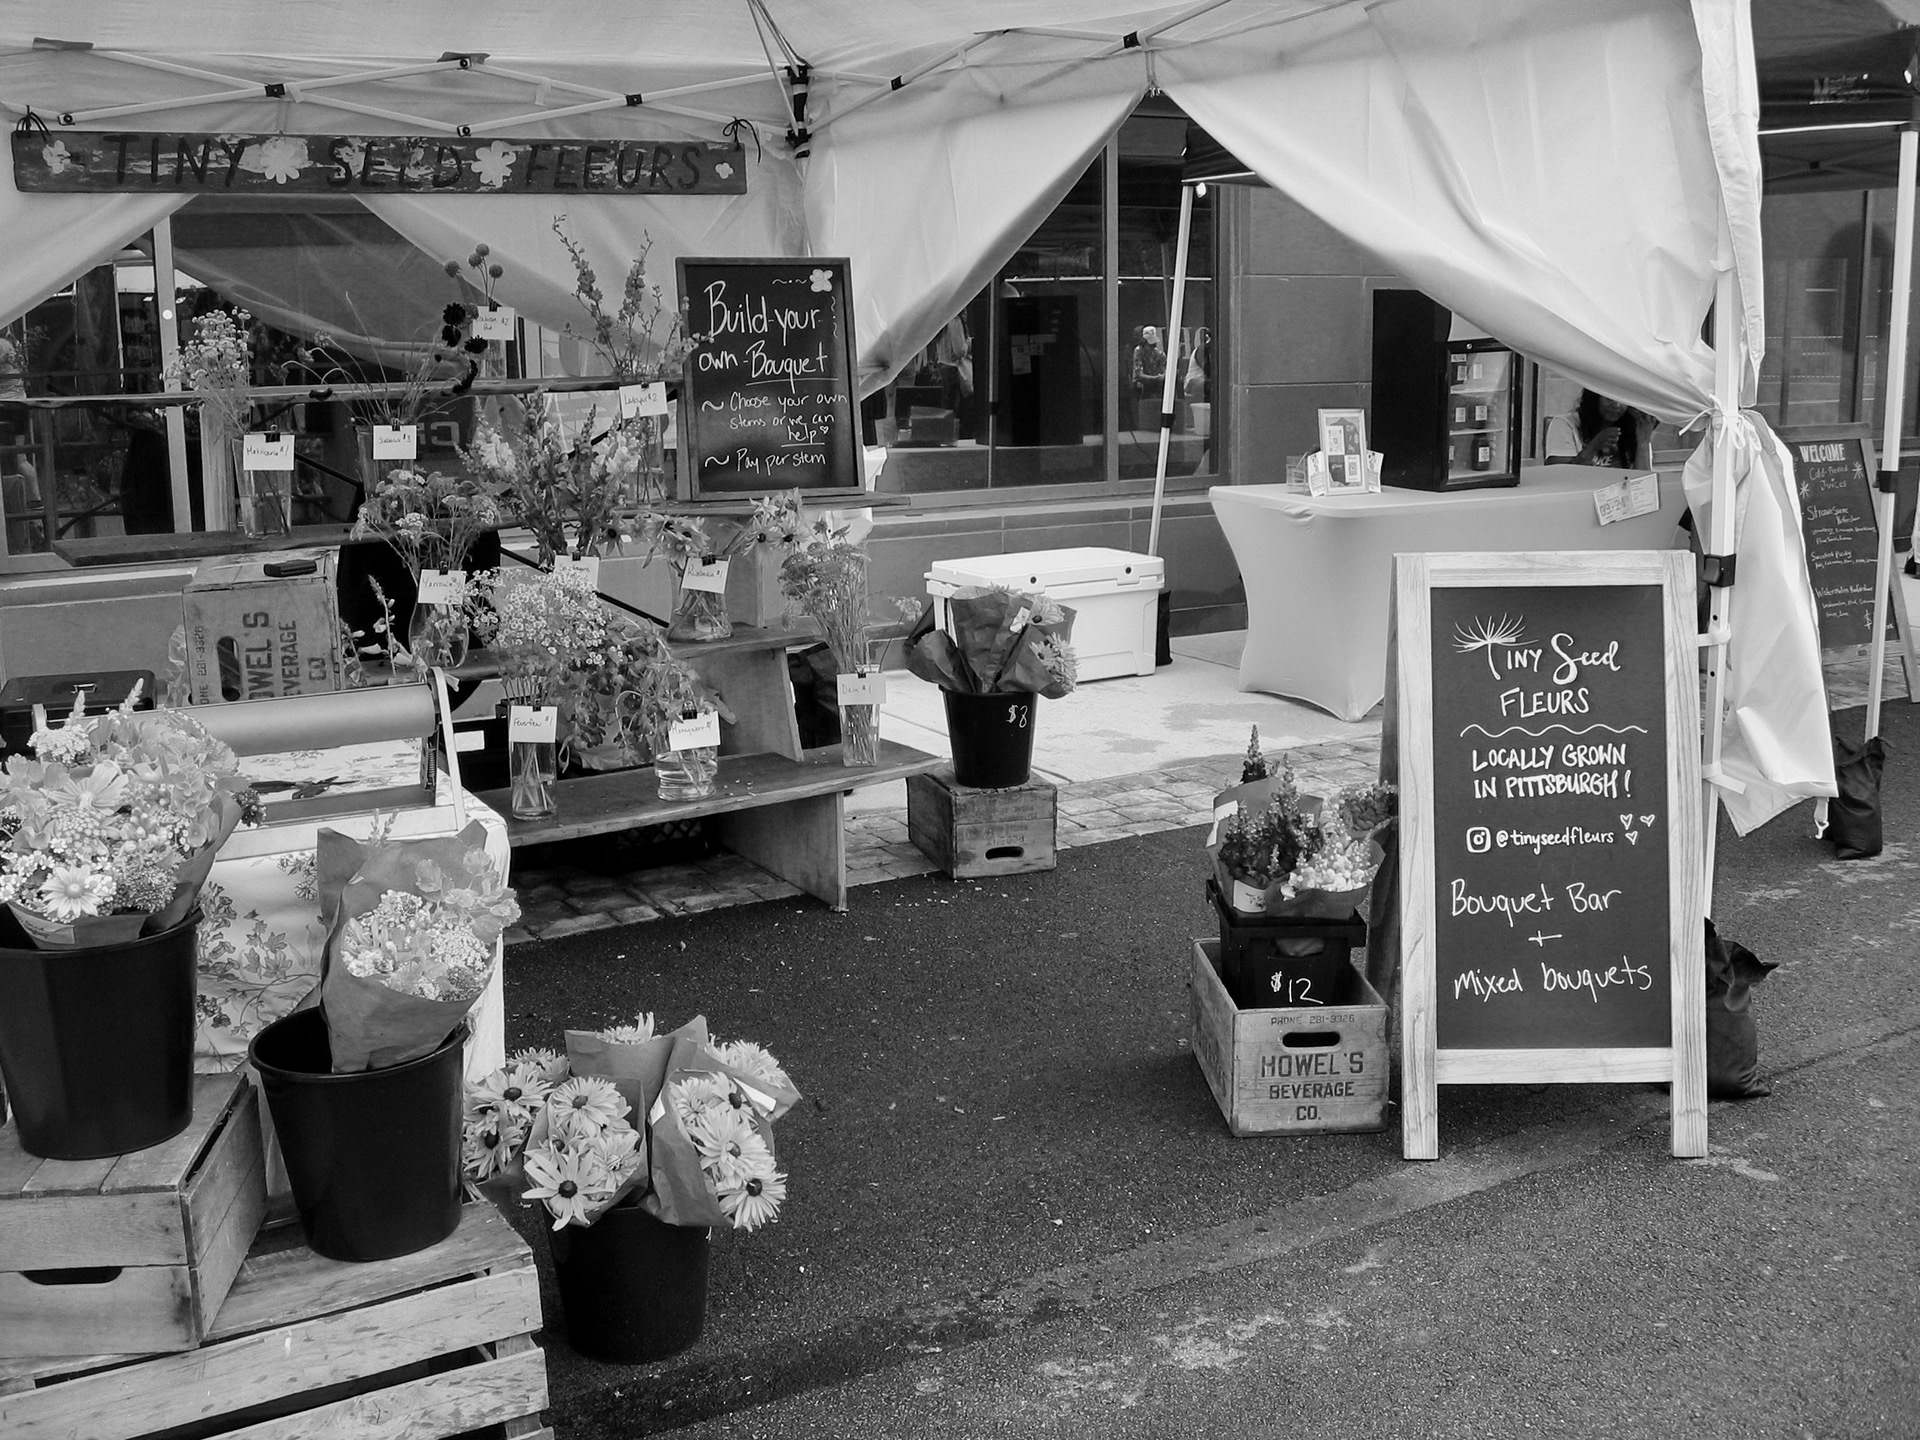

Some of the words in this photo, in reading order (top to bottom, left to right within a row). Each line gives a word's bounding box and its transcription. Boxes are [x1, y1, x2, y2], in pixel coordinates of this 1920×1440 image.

[103, 133, 253, 188] TINY
[525, 144, 701, 190] FLEURS
[778, 394, 810, 413] your
[816, 393, 847, 404] own
[729, 414, 767, 430] stems
[772, 414, 786, 427] or
[789, 416, 805, 427] we
[812, 411, 835, 424] can
[786, 424, 818, 445] help
[736, 447, 760, 474] Pay
[765, 453, 790, 476] per
[793, 450, 826, 467] stem
[1798, 443, 1847, 463] WELCOME
[242, 610, 275, 700] OWEL'S
[1550, 632, 1621, 685] Seed
[1500, 686, 1590, 719] FLEURS
[1471, 744, 1554, 772] LOCALLY
[1561, 742, 1627, 768] GROWN
[1474, 776, 1498, 799] IN
[1496, 826, 1615, 855] @tinyseedfleurs
[1450, 878, 1555, 928] Bouquet
[1565, 882, 1623, 914] Bar
[1270, 970, 1324, 1004] $12
[1453, 967, 1524, 1002] Mixed
[1270, 1016, 1302, 1026] PHONE
[1260, 1050, 1365, 1078] HOWEL'S
[1269, 1081, 1356, 1100] BEVERAGE
[1296, 1105, 1322, 1121] CO.
